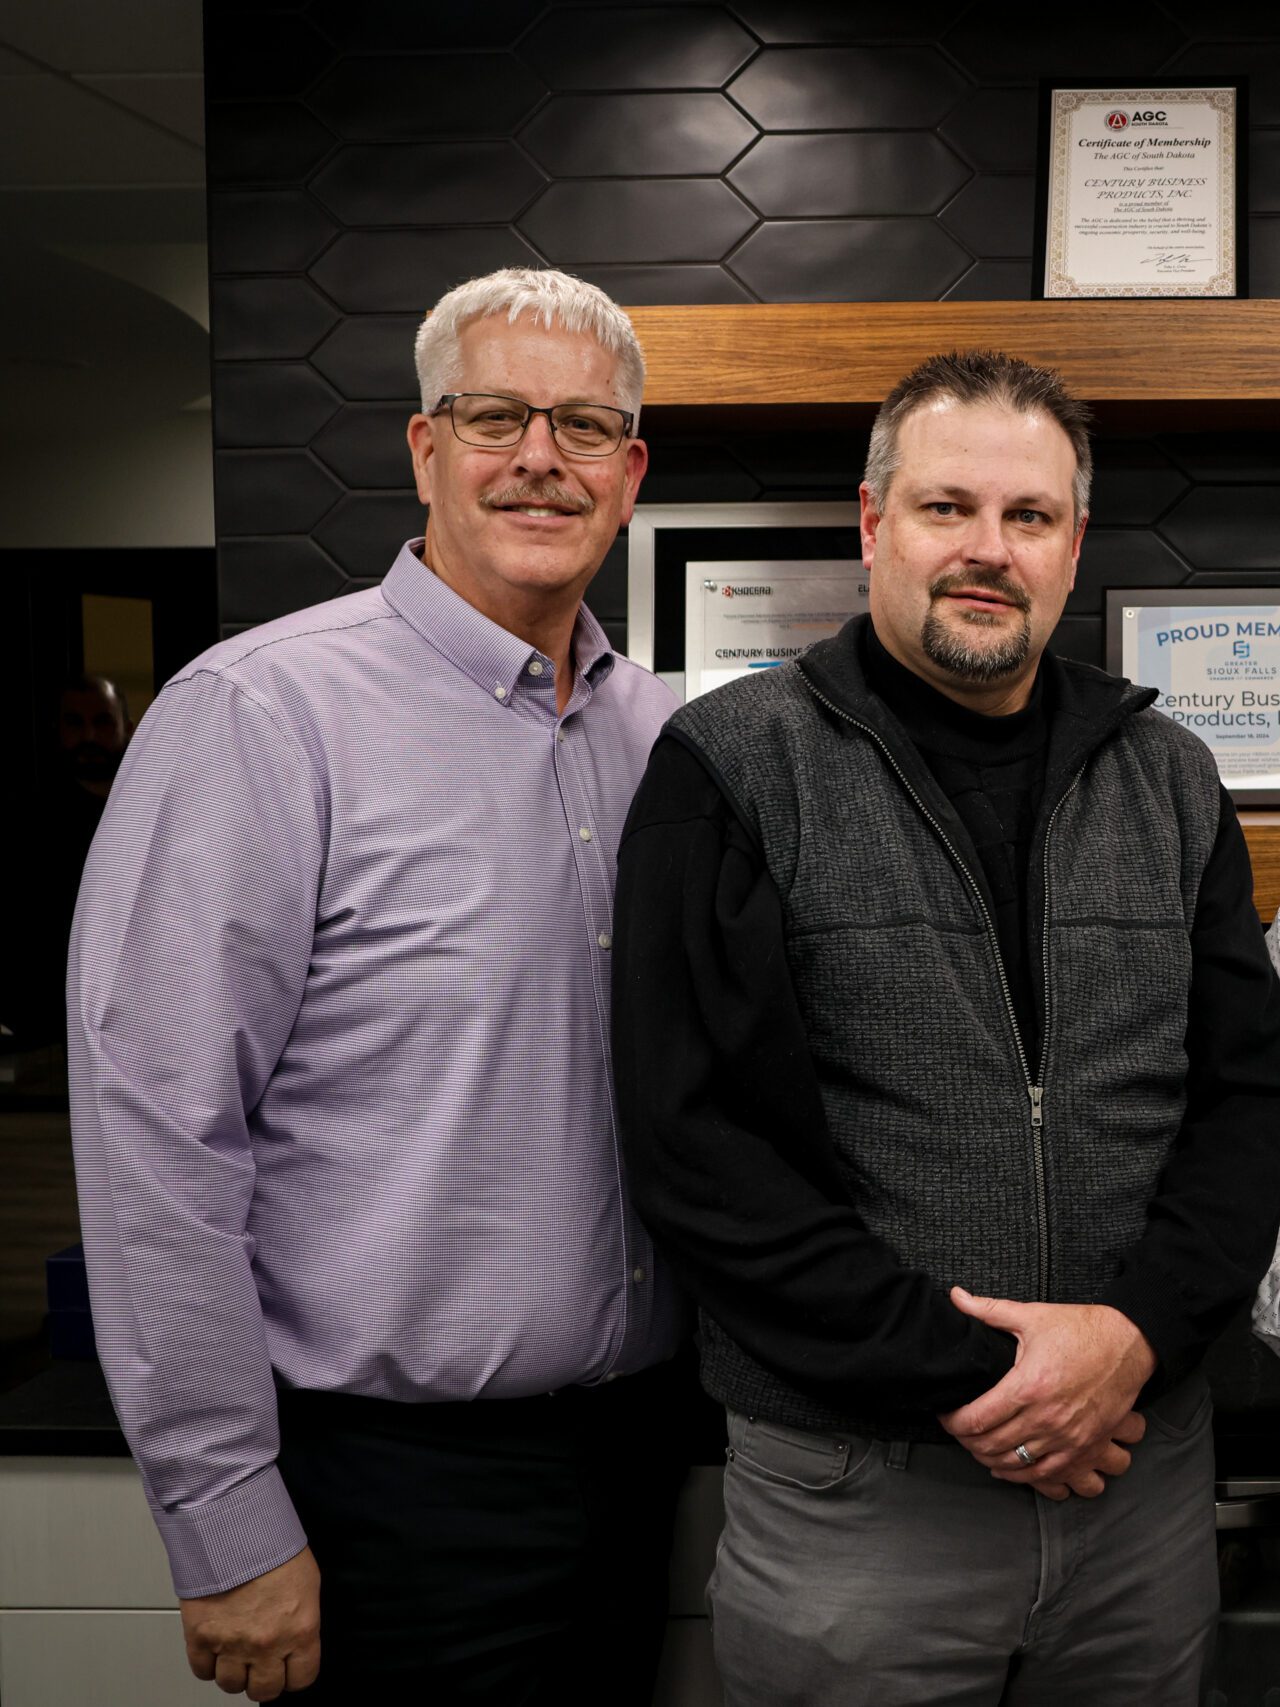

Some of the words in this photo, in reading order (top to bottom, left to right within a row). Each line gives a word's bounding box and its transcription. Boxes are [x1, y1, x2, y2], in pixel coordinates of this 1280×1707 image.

[1132, 111, 1167, 122] AGC
[1078, 138, 1133, 149] Certificate
[1134, 138, 1146, 149] of
[1147, 138, 1211, 148] Membership
[1132, 152, 1140, 161] of
[1084, 179, 1146, 188] CENTURY
[1148, 178, 1208, 186] BUSINESS
[1096, 190, 1164, 199] PRODUCTS,
[1167, 189, 1192, 198] INC.
[1156, 623, 1229, 646] PROUD
[715, 648, 762, 658] CENTURY
[1153, 691, 1235, 710] Century
[1172, 711, 1270, 728] Products,
